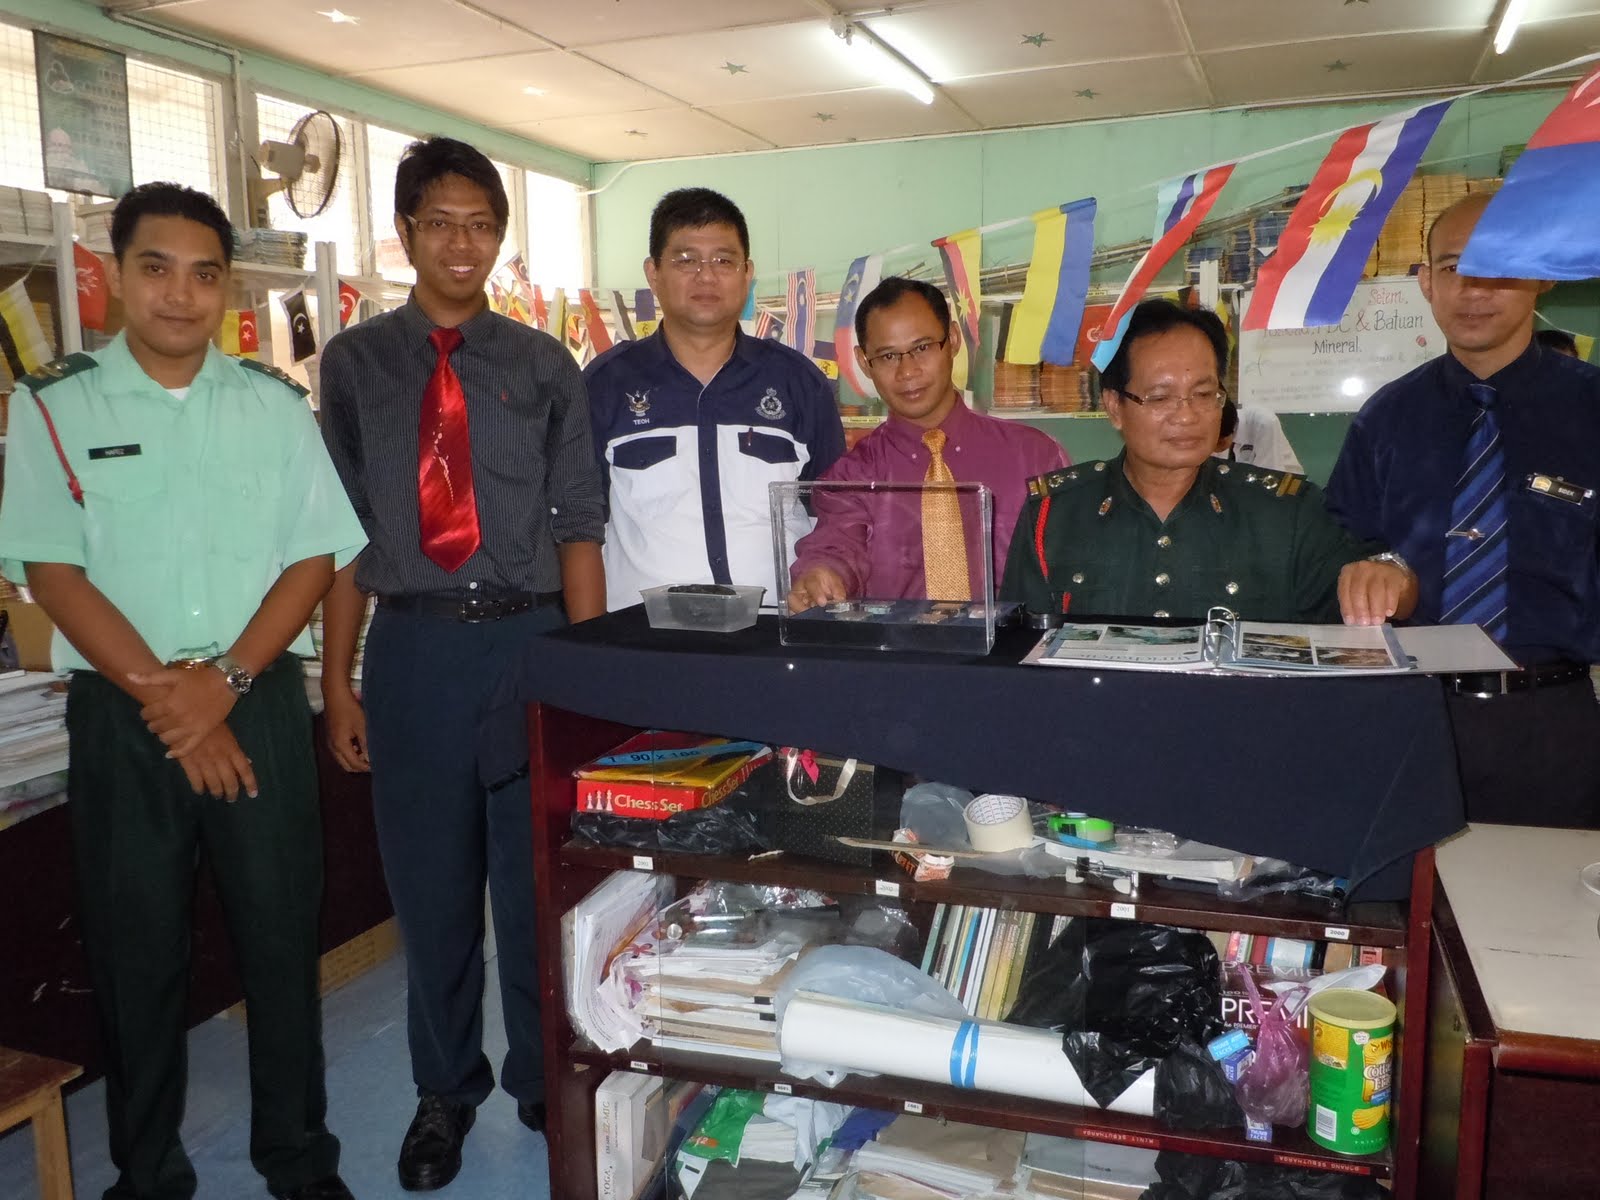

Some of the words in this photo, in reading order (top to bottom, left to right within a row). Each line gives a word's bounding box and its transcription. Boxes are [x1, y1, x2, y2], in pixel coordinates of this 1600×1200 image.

[1355, 308, 1371, 332] &
[1374, 309, 1424, 331] Batuan
[630, 753, 651, 762] 90
[614, 794, 659, 811] Chess
[659, 798, 684, 813] Set
[1329, 929, 1346, 937] 2000
[1222, 961, 1326, 978] PREMIE
[1278, 1156, 1327, 1168] SEBUTHARGA
